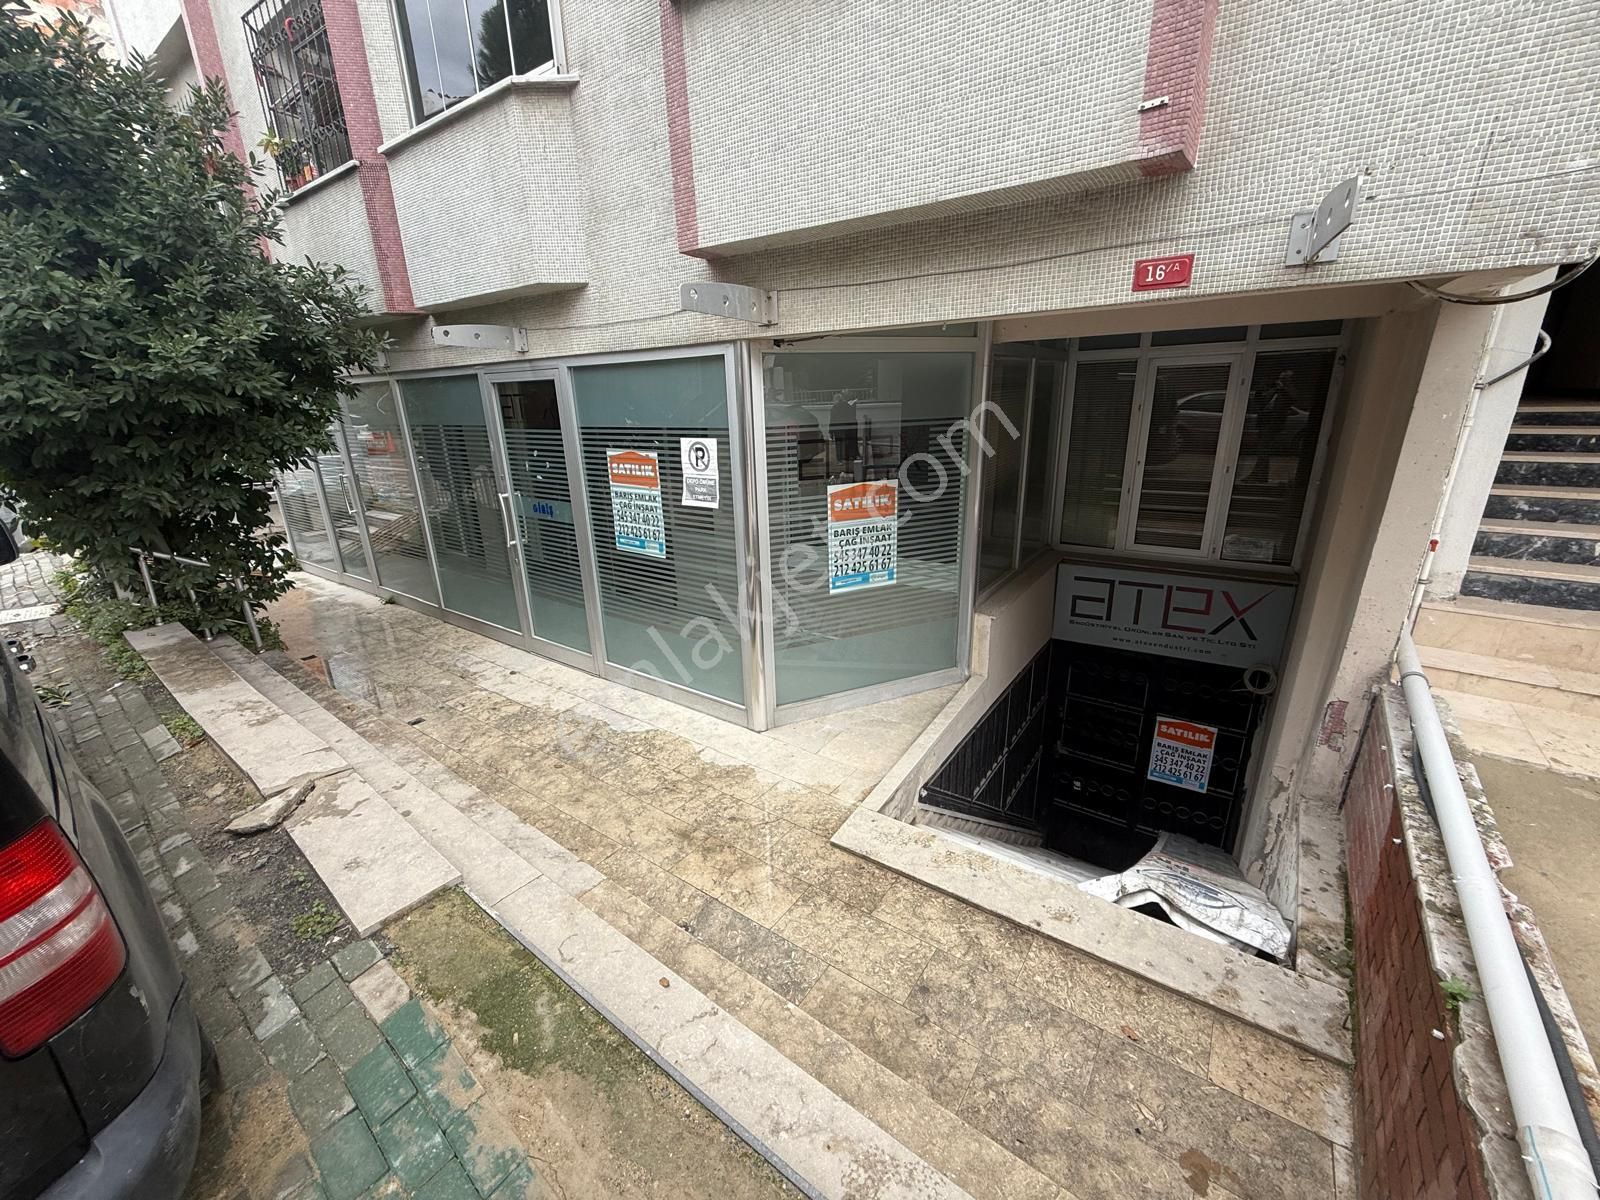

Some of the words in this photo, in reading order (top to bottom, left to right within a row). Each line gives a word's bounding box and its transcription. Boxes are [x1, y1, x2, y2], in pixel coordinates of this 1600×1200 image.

[1145, 263, 1180, 282] 16/A
[611, 463, 655, 477] SATILIK
[614, 491, 633, 502] BARIŞ
[635, 493, 658, 503] EMLAK
[620, 501, 632, 510] ÇAĞ
[833, 494, 892, 511] SATILIK
[617, 510, 628, 523] 545
[629, 511, 640, 524] 347
[642, 514, 650, 526] 40
[652, 515, 660, 528] 22
[618, 523, 630, 536] 212
[631, 526, 642, 538] 425
[643, 528, 651, 540] 61
[652, 529, 660, 541] 67
[833, 527, 860, 538] BARIŞ
[862, 523, 892, 534] EMLAK
[839, 538, 857, 549] ÇAĞ
[860, 533, 892, 545] İNŞAAT
[834, 548, 849, 563] 545
[852, 546, 867, 561] 347
[869, 545, 879, 558] 40
[881, 544, 891, 556] 22
[834, 563, 849, 577] 212
[851, 561, 867, 574] 425
[869, 559, 879, 572] 61
[881, 557, 891, 570] 67
[1160, 725, 1210, 742] SATILIK
[1181, 748, 1208, 759] EMLAK
[1153, 763, 1167, 773] 212
[1168, 767, 1182, 777] 425
[1183, 771, 1192, 780] 61
[1193, 774, 1204, 782] 67
[1154, 754, 1168, 765] 545
[1169, 757, 1183, 768] 347
[1185, 762, 1194, 771] 40
[1195, 766, 1205, 774] 22
